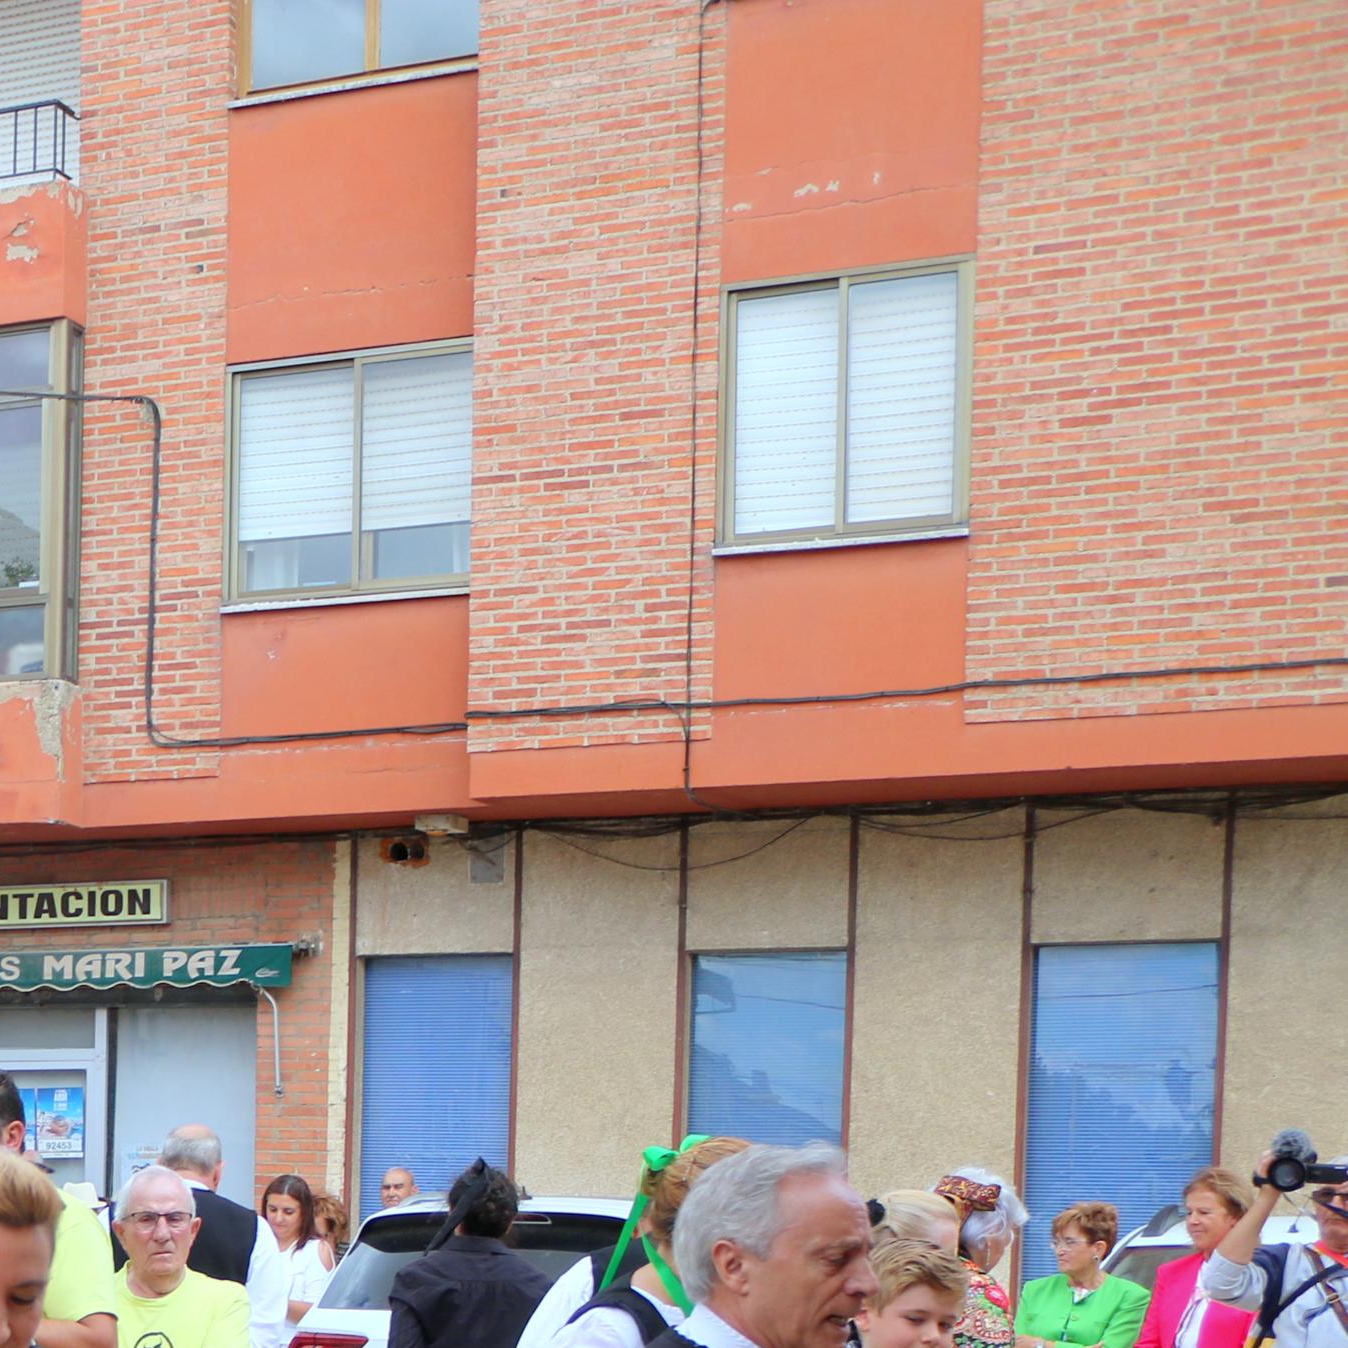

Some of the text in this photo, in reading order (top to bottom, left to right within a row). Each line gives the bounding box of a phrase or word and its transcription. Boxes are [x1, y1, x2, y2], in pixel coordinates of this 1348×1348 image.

[43, 950, 146, 981] MARI
[162, 948, 243, 978] PAZ
[45, 1141, 73, 1150] 92453
